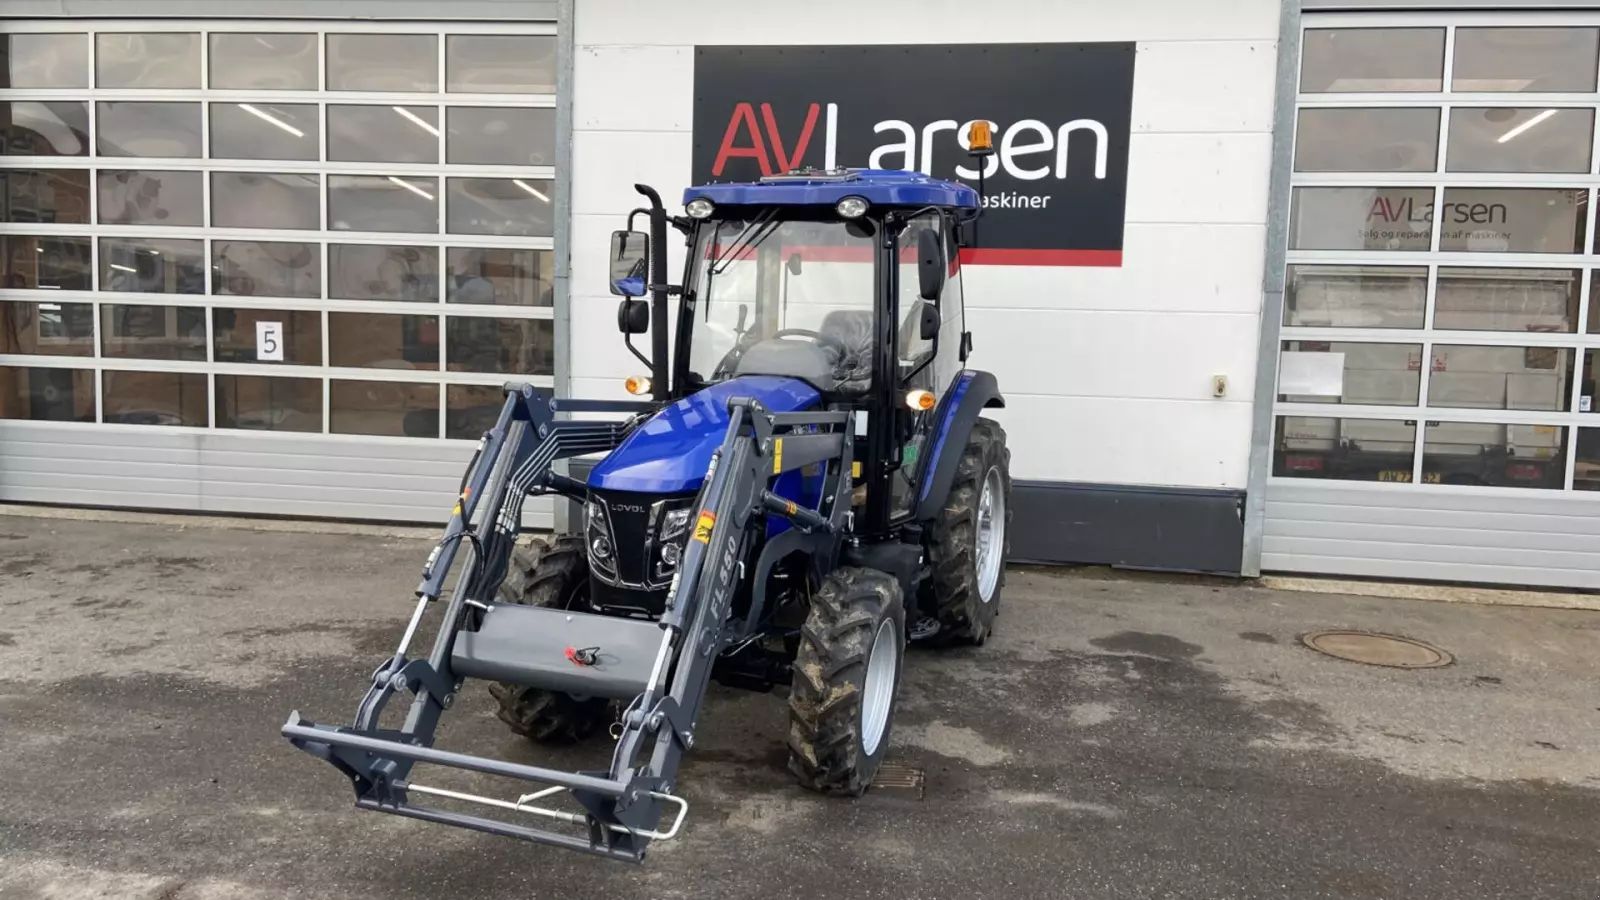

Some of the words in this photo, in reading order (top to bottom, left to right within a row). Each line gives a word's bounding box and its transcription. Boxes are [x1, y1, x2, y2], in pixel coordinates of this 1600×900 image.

[982, 191, 1051, 208] askiner
[1381, 231, 1394, 240] og
[264, 330, 277, 353] 5
[611, 503, 646, 513] LOVOL
